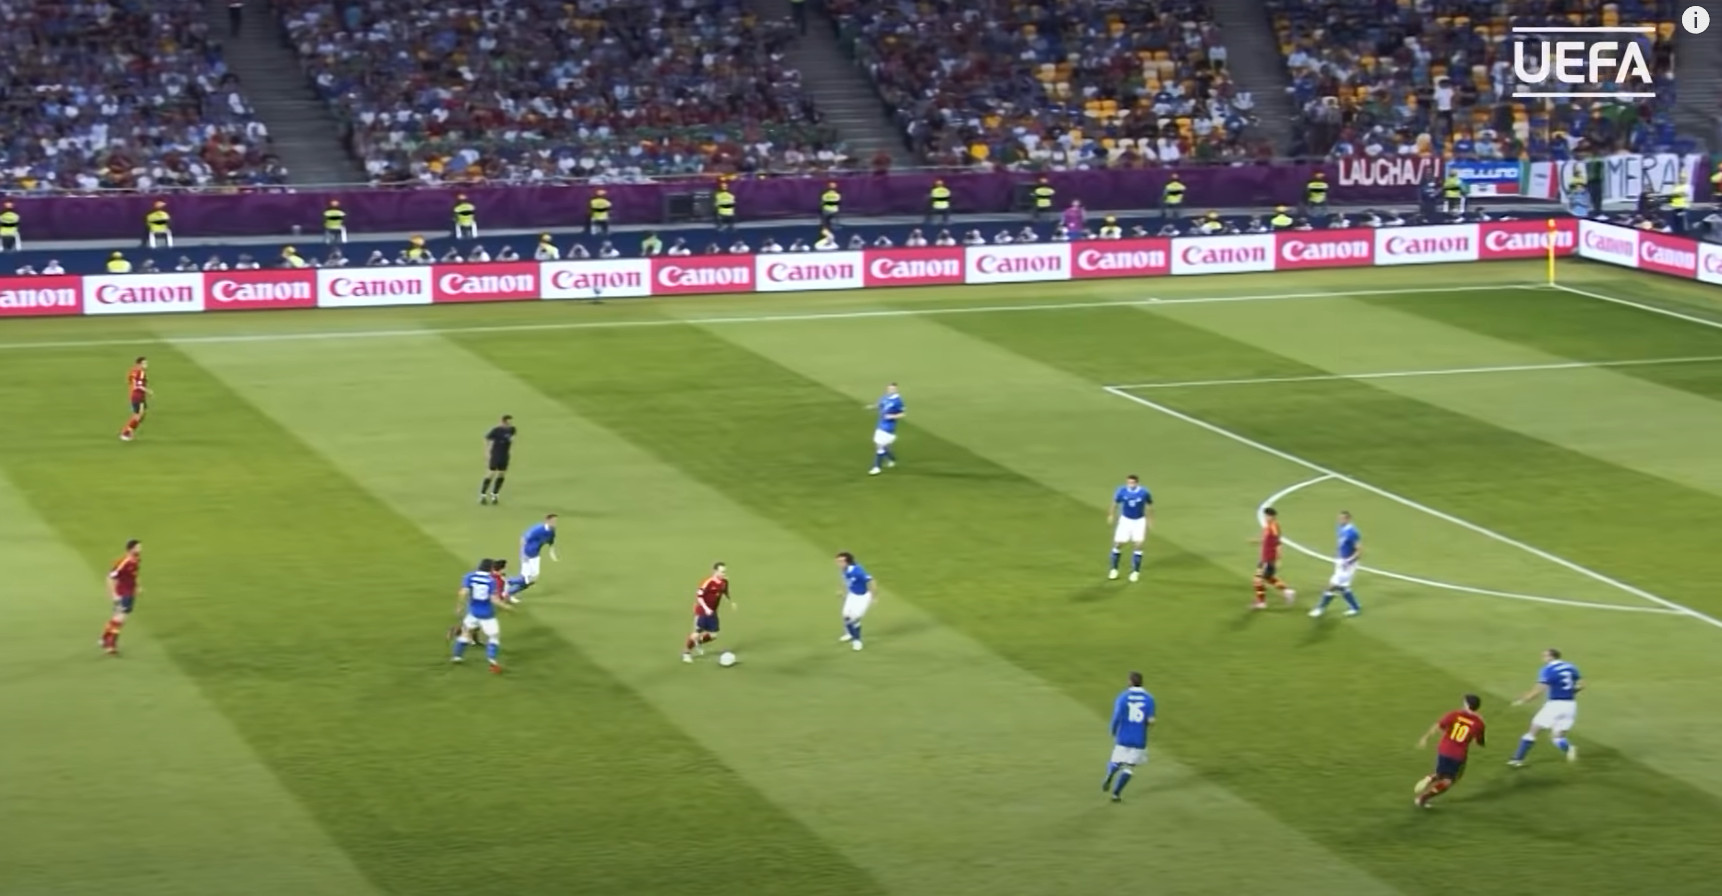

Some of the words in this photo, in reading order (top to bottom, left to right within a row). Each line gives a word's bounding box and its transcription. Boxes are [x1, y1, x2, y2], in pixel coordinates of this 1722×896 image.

[1281, 239, 1369, 262] Canon
[1385, 235, 1470, 255] Canon
[1485, 230, 1573, 252] Canon
[1584, 229, 1634, 258] Canon
[976, 254, 1061, 274] Canon
[1077, 249, 1166, 271] Canon
[1182, 246, 1266, 265] Canon
[1641, 240, 1696, 271] Canon
[658, 265, 750, 287] Canon
[767, 262, 855, 282] Canon
[870, 257, 960, 279] Canon
[329, 277, 422, 297] Canon
[439, 272, 534, 295] Canon
[552, 269, 642, 289] Canon
[0, 288, 76, 307] anon
[95, 283, 194, 304] Canon
[212, 279, 311, 302] Canon
[1450, 722, 1470, 742] 10
